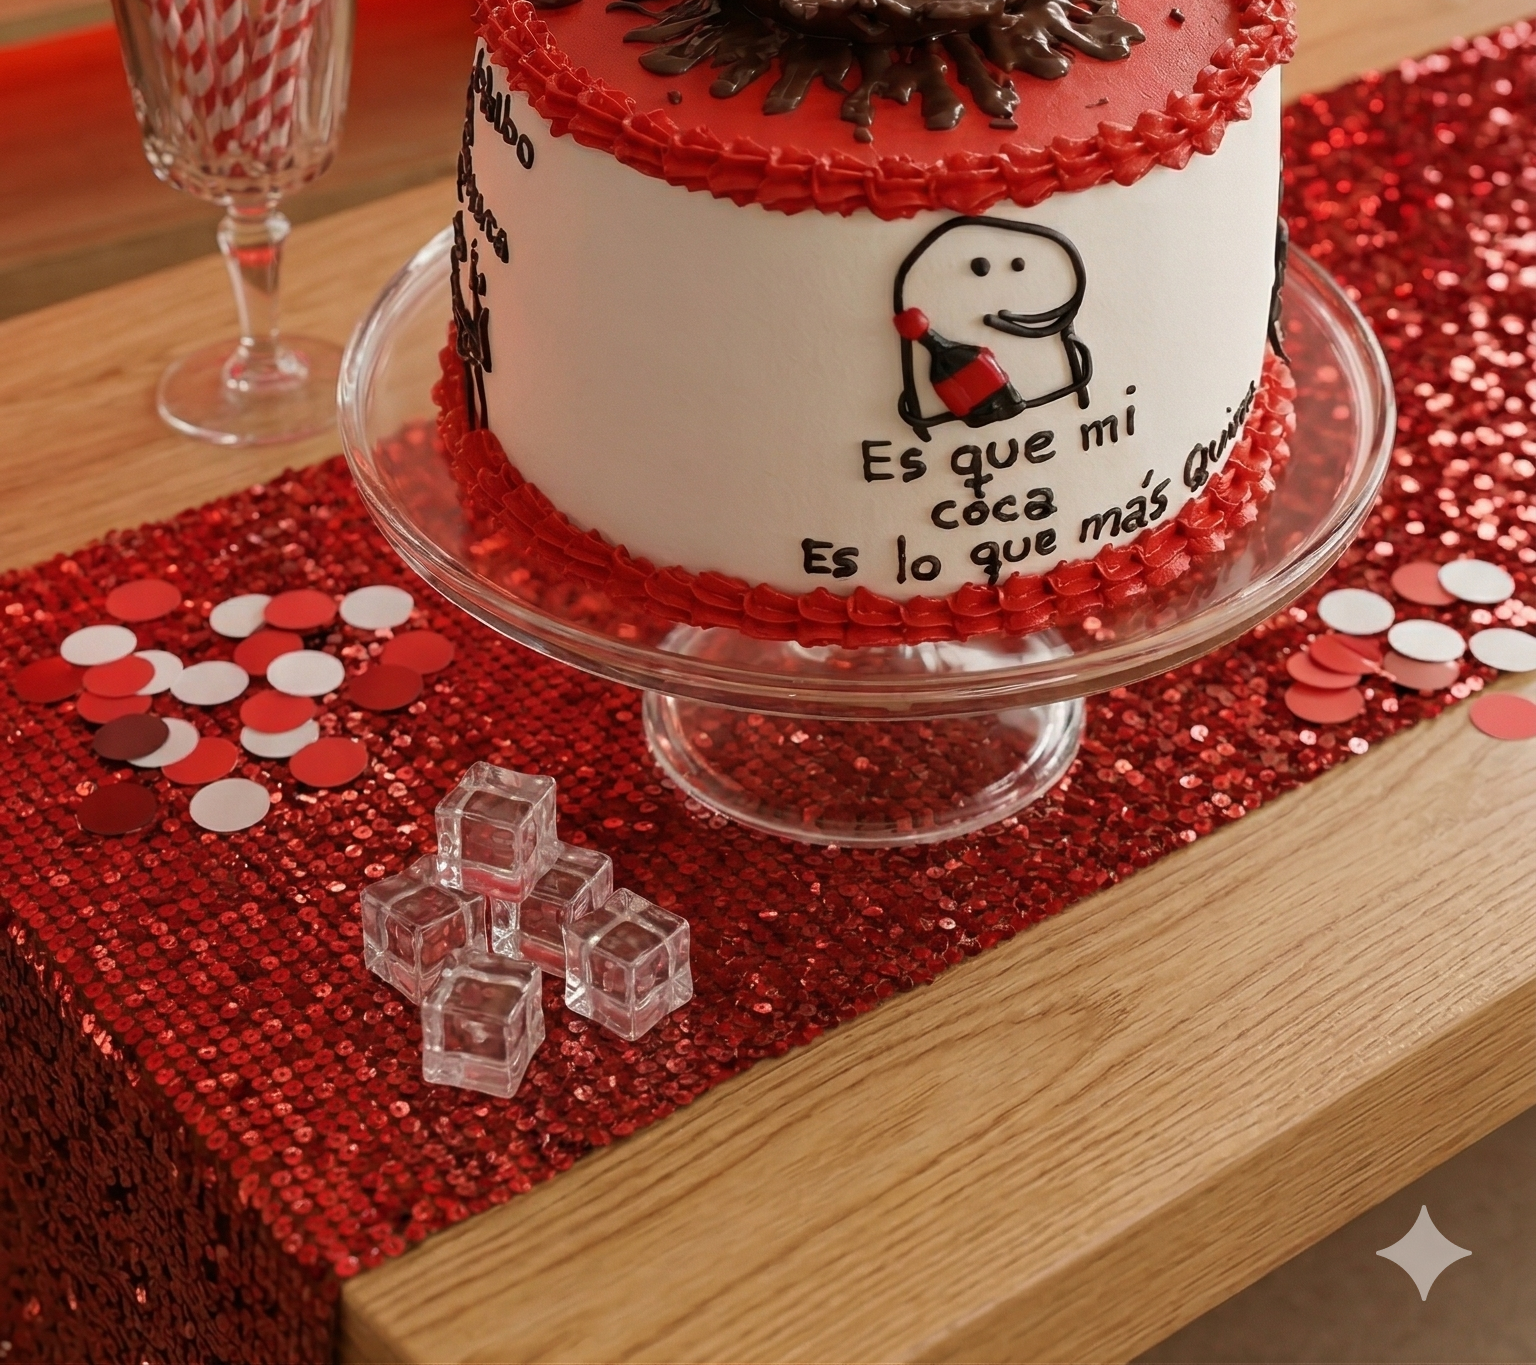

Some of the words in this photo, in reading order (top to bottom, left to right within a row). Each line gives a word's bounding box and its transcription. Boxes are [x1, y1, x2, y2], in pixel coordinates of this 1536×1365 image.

[862, 440, 926, 483] Es
[951, 431, 1055, 499] que
[1081, 385, 1136, 449] mi
[801, 538, 859, 578] Es
[897, 535, 941, 584] lo
[970, 529, 1056, 586] que
[1080, 470, 1170, 543] más
[931, 488, 1057, 530] coca
